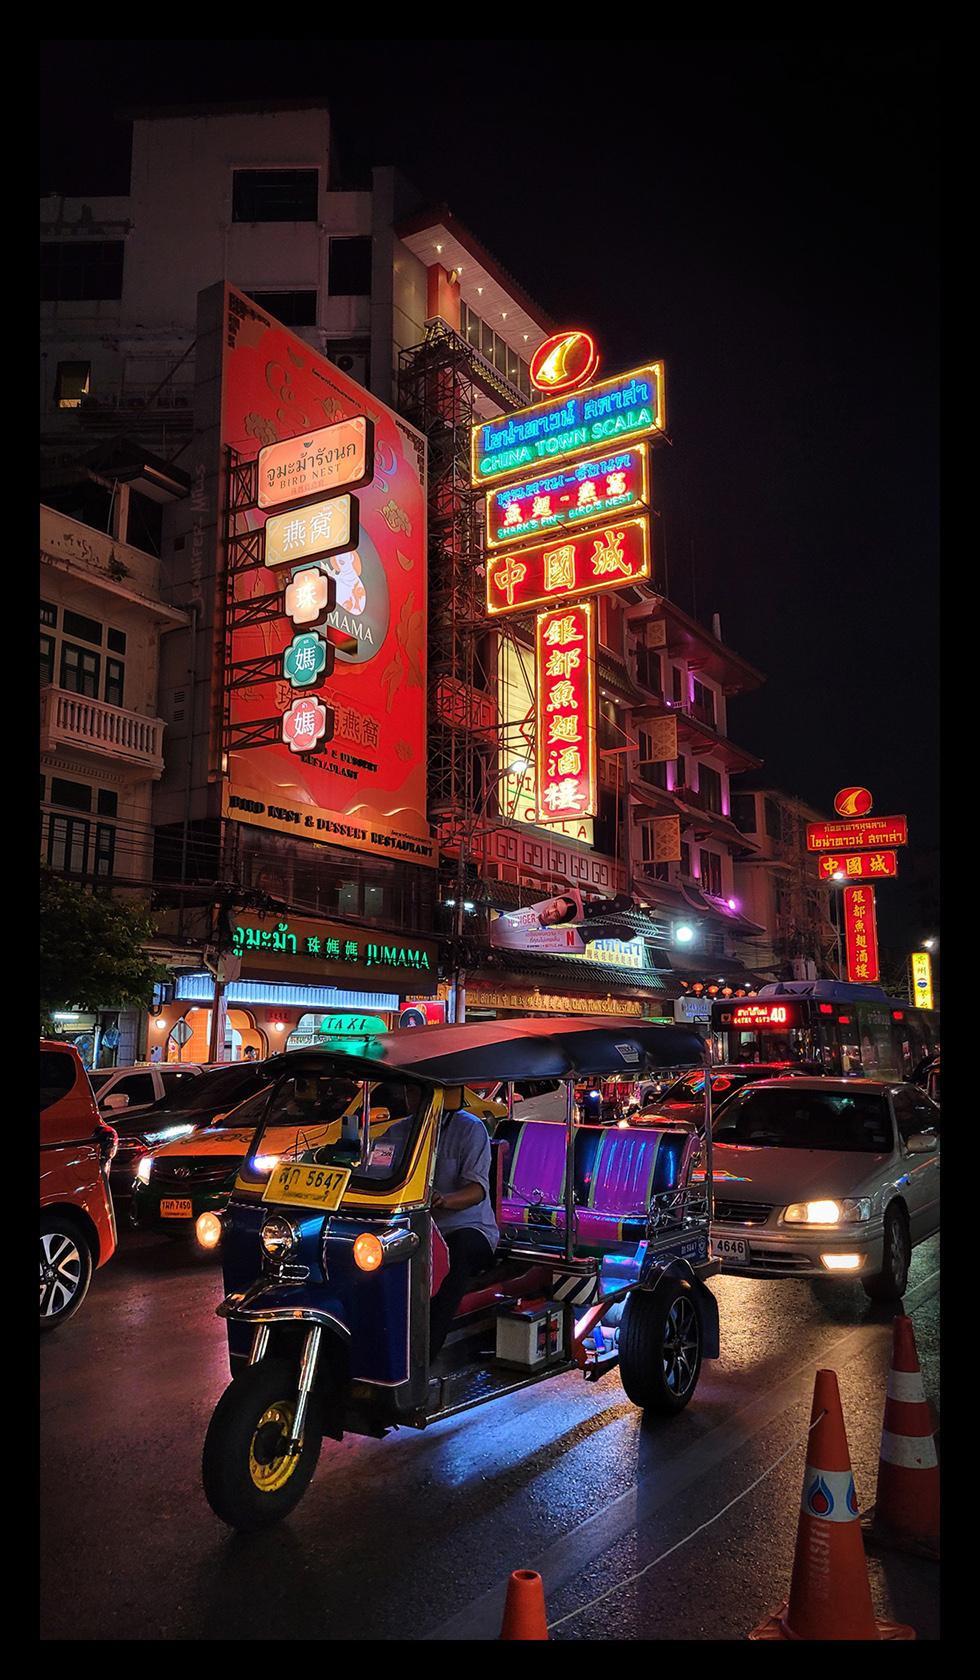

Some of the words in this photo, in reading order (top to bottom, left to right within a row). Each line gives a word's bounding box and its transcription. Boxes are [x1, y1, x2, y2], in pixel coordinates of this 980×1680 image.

[482, 400, 576, 451] ไชน่าทาวน์
[584, 380, 649, 420] สกาล่า
[480, 446, 532, 473] CHINA
[535, 427, 587, 456] TOWN
[591, 408, 651, 439] SCALA
[266, 443, 356, 487] จูมะม้ารังนก
[280, 473, 307, 489] BIRD
[312, 463, 341, 478] NEST
[605, 491, 633, 508] NEST
[282, 511, 333, 552] 燕窩
[494, 531, 632, 605] 中國城
[294, 645, 316, 674] 媽
[293, 710, 315, 738] 媽
[543, 615, 586, 812] 銀都魚翅酒樓
[229, 795, 265, 814] BIRD
[267, 805, 303, 824] NEST
[304, 815, 314, 827] &
[316, 818, 368, 841] DESSERT
[370, 831, 433, 857] RESTAURANT
[868, 829, 903, 844] สกาล่า
[823, 854, 889, 875] 中國城
[232, 922, 297, 957] จูมะม้า
[366, 943, 430, 970] JUMAMA
[566, 930, 575, 946] N
[327, 1017, 367, 1031] TAXI
[770, 1006, 786, 1023] 40
[306, 1170, 344, 1191] 5647
[176, 1200, 190, 1210] 7450
[717, 1240, 744, 1254] 4646
